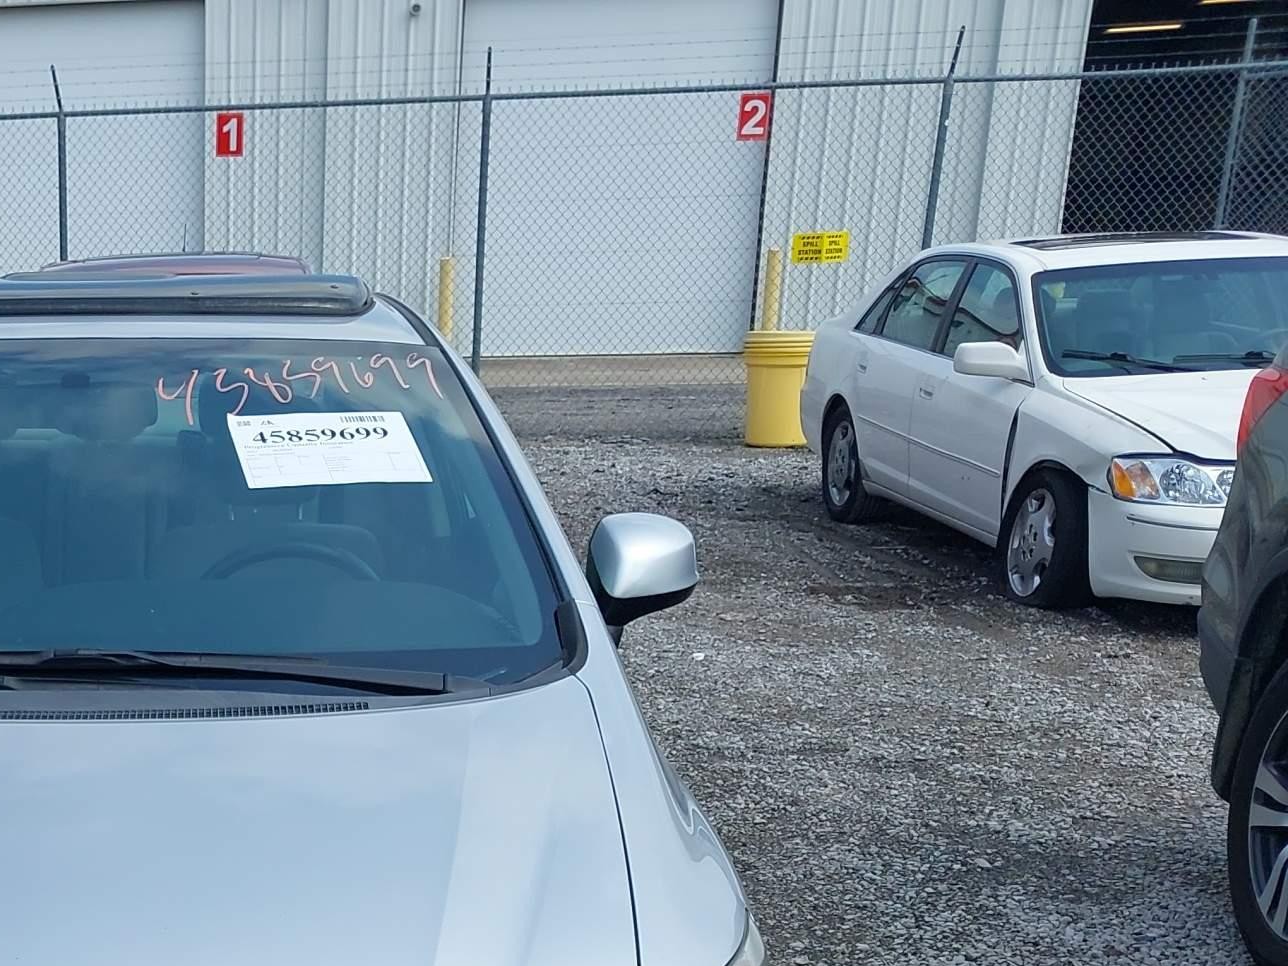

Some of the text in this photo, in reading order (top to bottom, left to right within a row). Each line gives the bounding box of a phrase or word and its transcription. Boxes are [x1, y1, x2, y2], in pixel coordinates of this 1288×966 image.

[741, 99, 766, 135] 2
[222, 117, 238, 151] 1
[797, 248, 822, 256] STATION
[802, 240, 819, 248] SPILL
[157, 352, 444, 425] 45859699
[252, 426, 389, 445] 45859699
